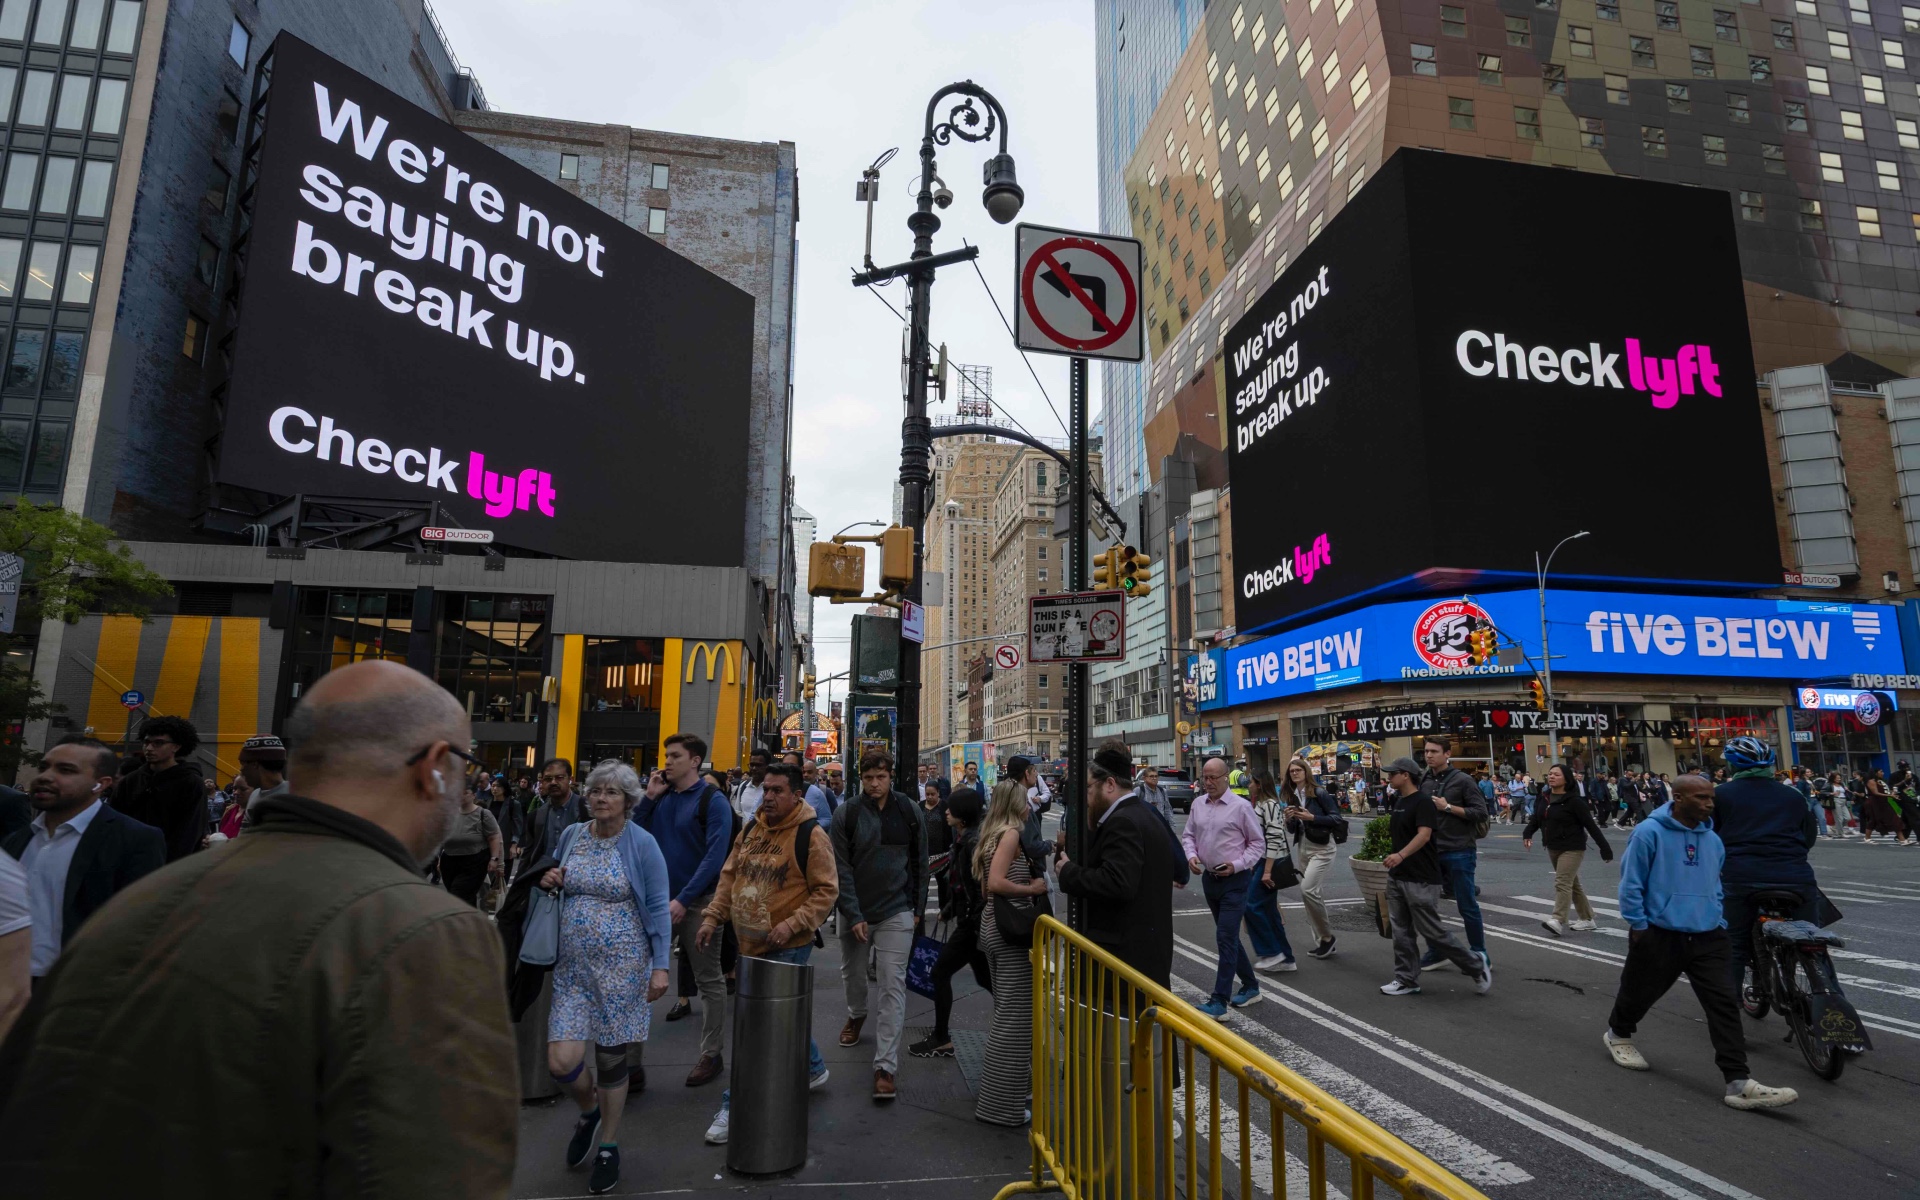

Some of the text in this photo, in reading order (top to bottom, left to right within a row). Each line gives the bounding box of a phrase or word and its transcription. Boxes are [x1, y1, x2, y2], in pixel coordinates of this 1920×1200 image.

[314, 81, 605, 278] We're not
[300, 164, 526, 304] saying
[292, 220, 586, 385] break up.
[1234, 264, 1330, 378] We're not
[1236, 340, 1299, 415] saying
[1456, 329, 1723, 409] Check lyft
[1237, 366, 1331, 454] break up.
[269, 406, 556, 518] Check lyft
[425, 529, 490, 540] BIG OUTDOOR
[0, 553, 17, 568] ENIE
[1243, 533, 1331, 599] Check lyft
[0, 582, 15, 593] ENIE
[1784, 574, 1838, 585] BIG OUTDOOR
[1073, 596, 1097, 604] SQUARE
[1034, 609, 1082, 621] THIS IS A
[1422, 605, 1464, 630] cool stuff
[1034, 621, 1087, 633] GUN FE
[1585, 610, 1830, 660] five BELOW
[1237, 628, 1362, 690] five BELOW
[1432, 655, 1458, 667] five
[1401, 664, 1515, 679] fivebelow.com
[1852, 674, 1885, 688] five
[1824, 694, 1850, 706] five
[1340, 720, 1348, 735] I
[1383, 712, 1432, 733] GIFTS
[1482, 710, 1492, 728] I
[1509, 711, 1541, 729] NY
